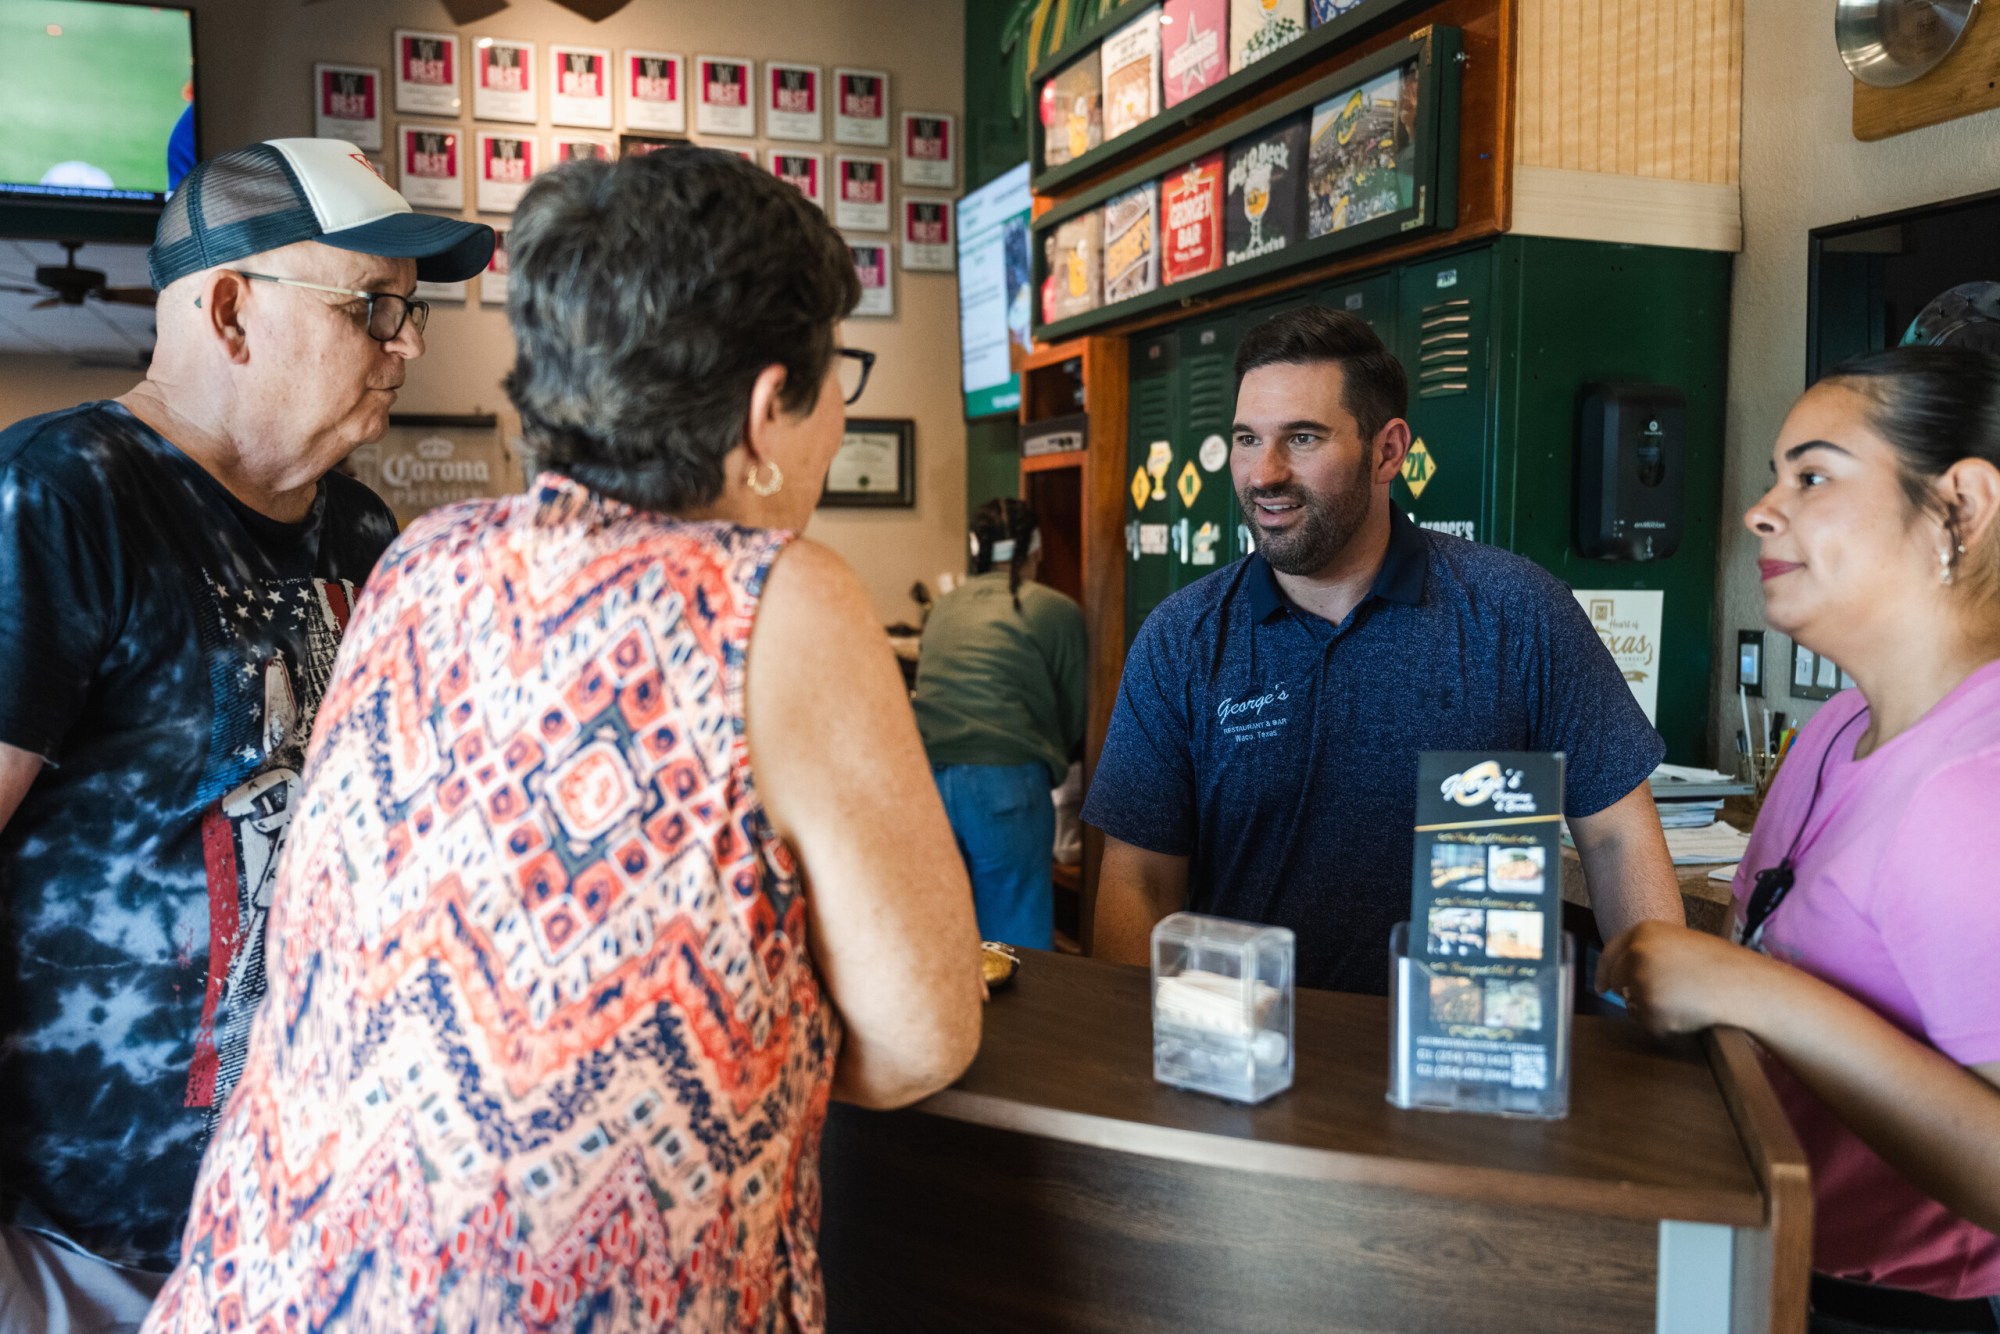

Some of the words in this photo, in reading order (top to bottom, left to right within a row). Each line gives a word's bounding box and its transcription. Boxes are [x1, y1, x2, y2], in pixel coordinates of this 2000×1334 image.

[1177, 223, 1202, 250] BAR
[382, 453, 490, 488] Corona
[1406, 451, 1427, 482] 2X
[1217, 682, 1290, 725] George's
[1223, 721, 1265, 734] RESTAURANT
[1272, 717, 1288, 727] BAR
[1257, 729, 1278, 739] Texas
